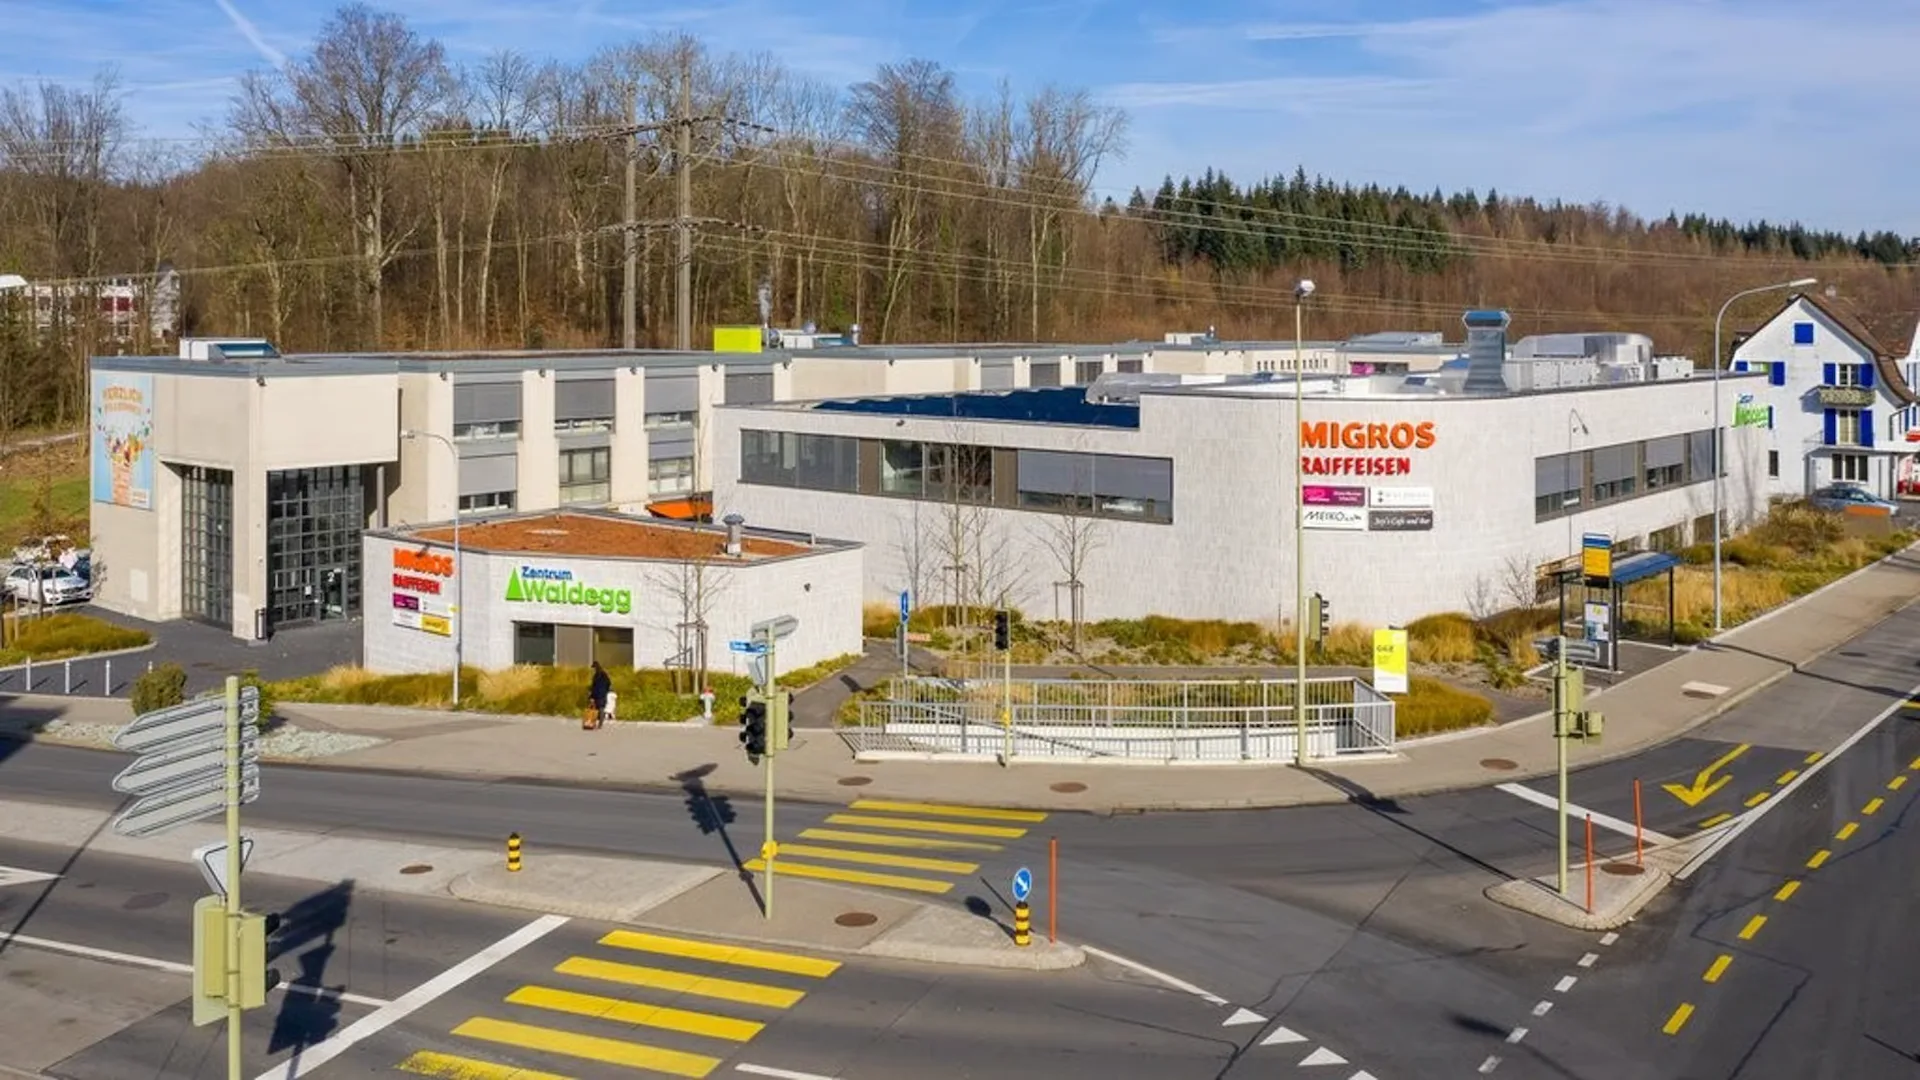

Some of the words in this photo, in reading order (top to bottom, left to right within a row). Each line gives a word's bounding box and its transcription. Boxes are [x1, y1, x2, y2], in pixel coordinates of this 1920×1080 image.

[1301, 421, 1435, 449] MIGROS
[1301, 456, 1410, 475] RAIFFEISEN
[522, 566, 573, 580] Zentrum
[523, 579, 632, 614] Waldegg
